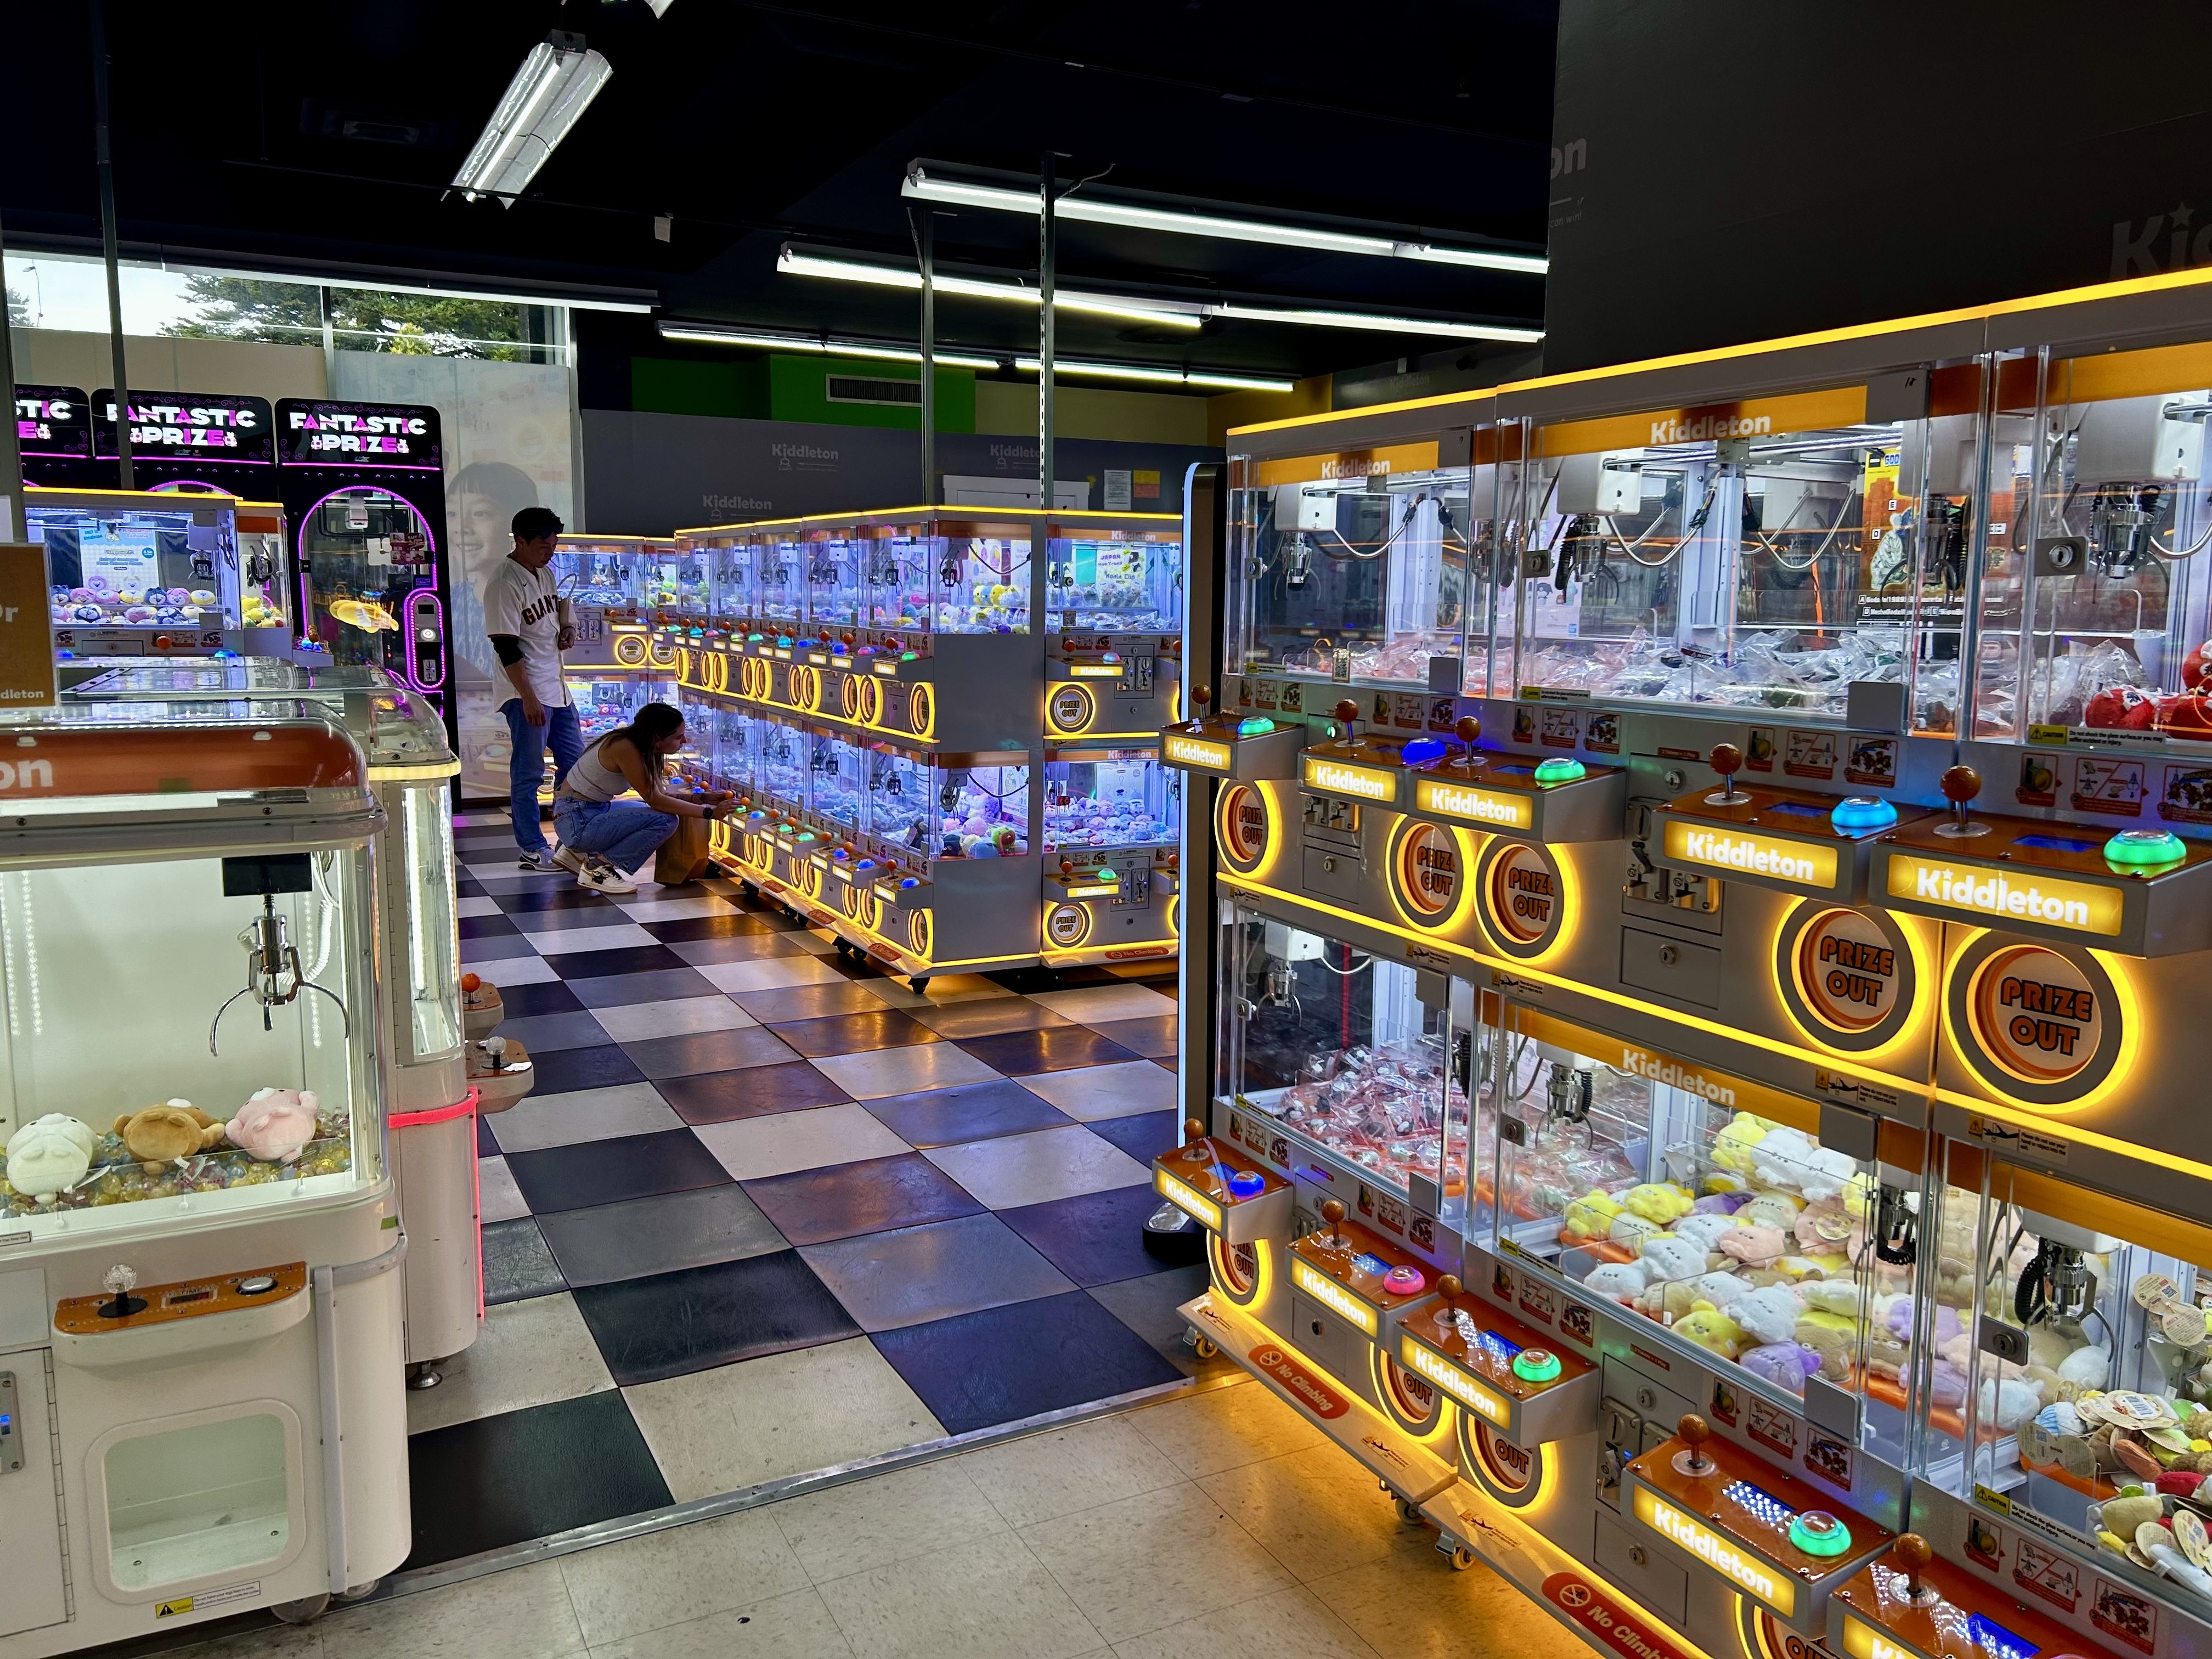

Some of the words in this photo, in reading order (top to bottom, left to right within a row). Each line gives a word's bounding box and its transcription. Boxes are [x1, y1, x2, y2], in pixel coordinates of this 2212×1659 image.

[15, 399, 72, 420] TIC
[289, 411, 426, 435] FANTASTIC
[142, 426, 225, 447] PRIZE
[321, 433, 398, 453] PRIZE
[1650, 415, 1771, 444] Kiddleton
[771, 443, 839, 460] Kiddleton
[1321, 459, 1390, 479] Kiddleton
[703, 494, 772, 510] Kiddleton
[1111, 530, 1156, 541] Kiddleton
[1059, 700, 1080, 709] PRIZE
[1062, 709, 1077, 717] OUT
[1108, 750, 1152, 760] Kiddleton
[1173, 740, 1222, 767] Kiddleton
[1316, 767, 1384, 798] Kiddleton
[1431, 788, 1517, 823] Kiddleton
[1687, 832, 1813, 882] Kiddleton
[1076, 888, 1110, 896] Kiddleton
[1420, 870, 1453, 896] OUT
[1513, 894, 1551, 922] OUT
[1917, 868, 2087, 926] Kiddleton
[1056, 916, 1076, 924] PRIZE
[1058, 924, 1074, 933] OUT
[1820, 934, 1895, 977] PRIZE
[1825, 968, 1883, 1007] OUT
[2000, 975, 2094, 1023] PRIZE
[2006, 1014, 2081, 1057] OUT
[1623, 1049, 1735, 1106] Kiddleton
[1167, 1177, 1214, 1223] Kiddleton
[1301, 1268, 1368, 1328] Kiddleton
[1276, 1364, 1293, 1379] No
[1291, 1376, 1334, 1412] Climbing
[1403, 1372, 1433, 1407] OUT
[1415, 1345, 1496, 1418] Kiddleton
[1494, 1438, 1532, 1475] OUT
[1988, 1495, 2007, 1508] CAUTION
[2012, 1510, 2023, 1519] suffer
[2026, 1510, 2038, 1521] shock
[2046, 1522, 2056, 1531] glass
[2085, 1541, 2096, 1550] may
[1654, 1502, 1773, 1600] Kiddleton
[173, 1603, 192, 1611] Caution
[1586, 1604, 1615, 1631] No
